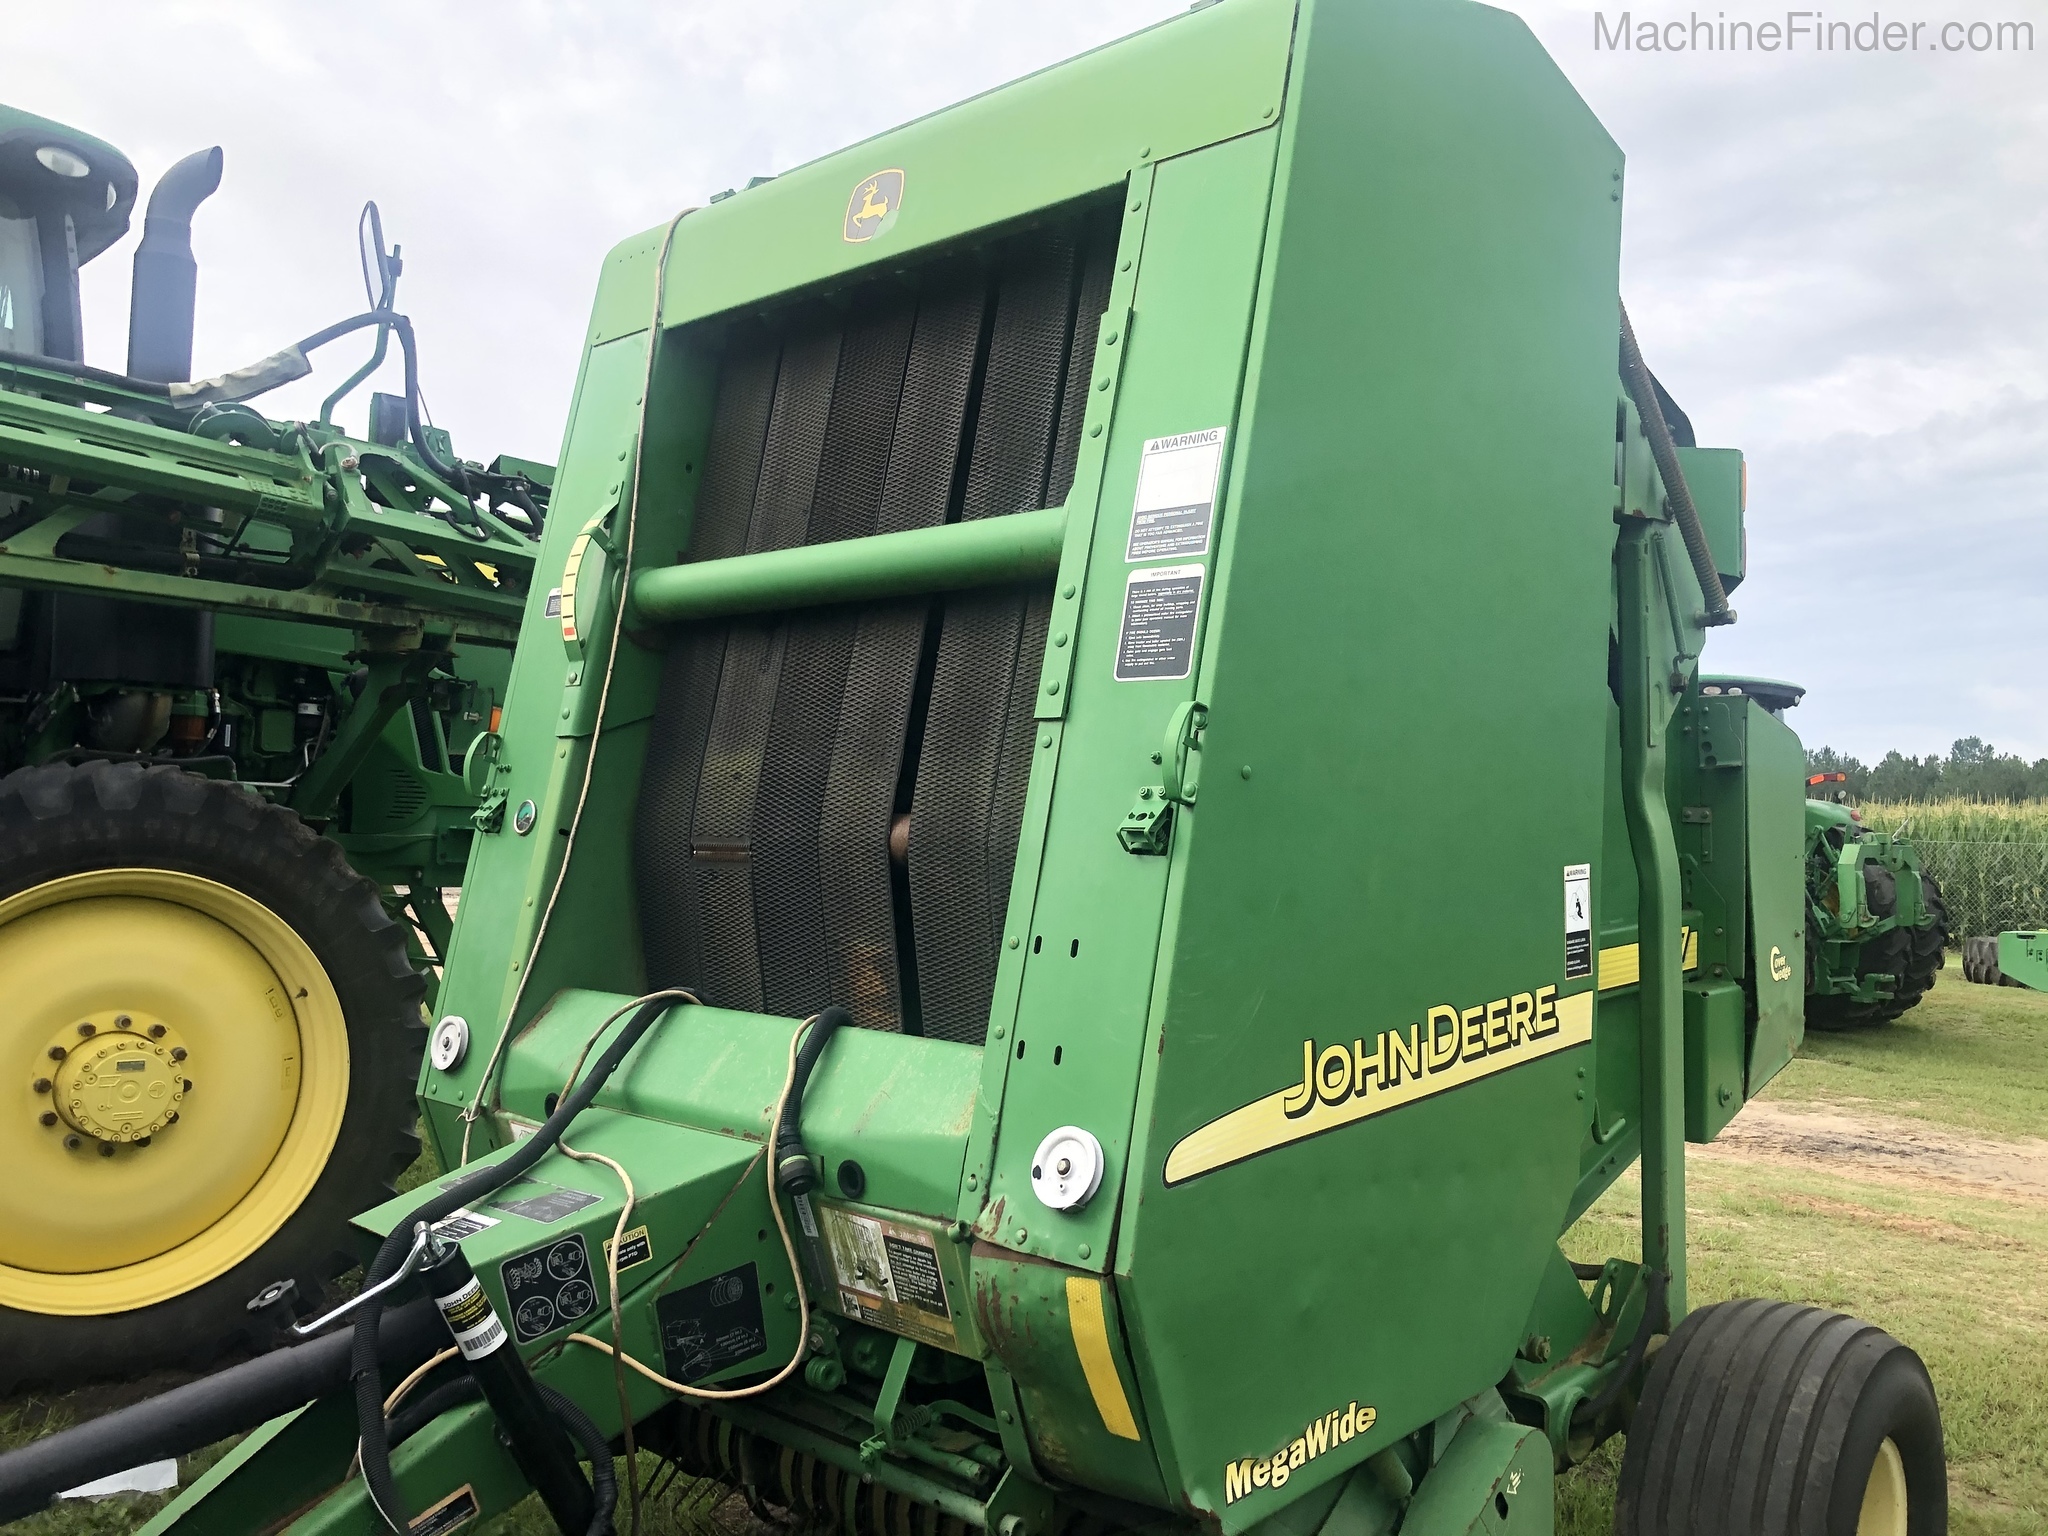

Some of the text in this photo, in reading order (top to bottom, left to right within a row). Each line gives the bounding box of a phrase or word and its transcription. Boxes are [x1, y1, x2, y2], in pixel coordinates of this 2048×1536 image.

[1161, 430, 1218, 450] WARNING
[1150, 569, 1182, 578] IMPORTANT
[1284, 984, 1560, 1119] JOHN DEERE
[443, 1298, 462, 1309] JOHN
[1225, 1400, 1378, 1507] MegaWide
